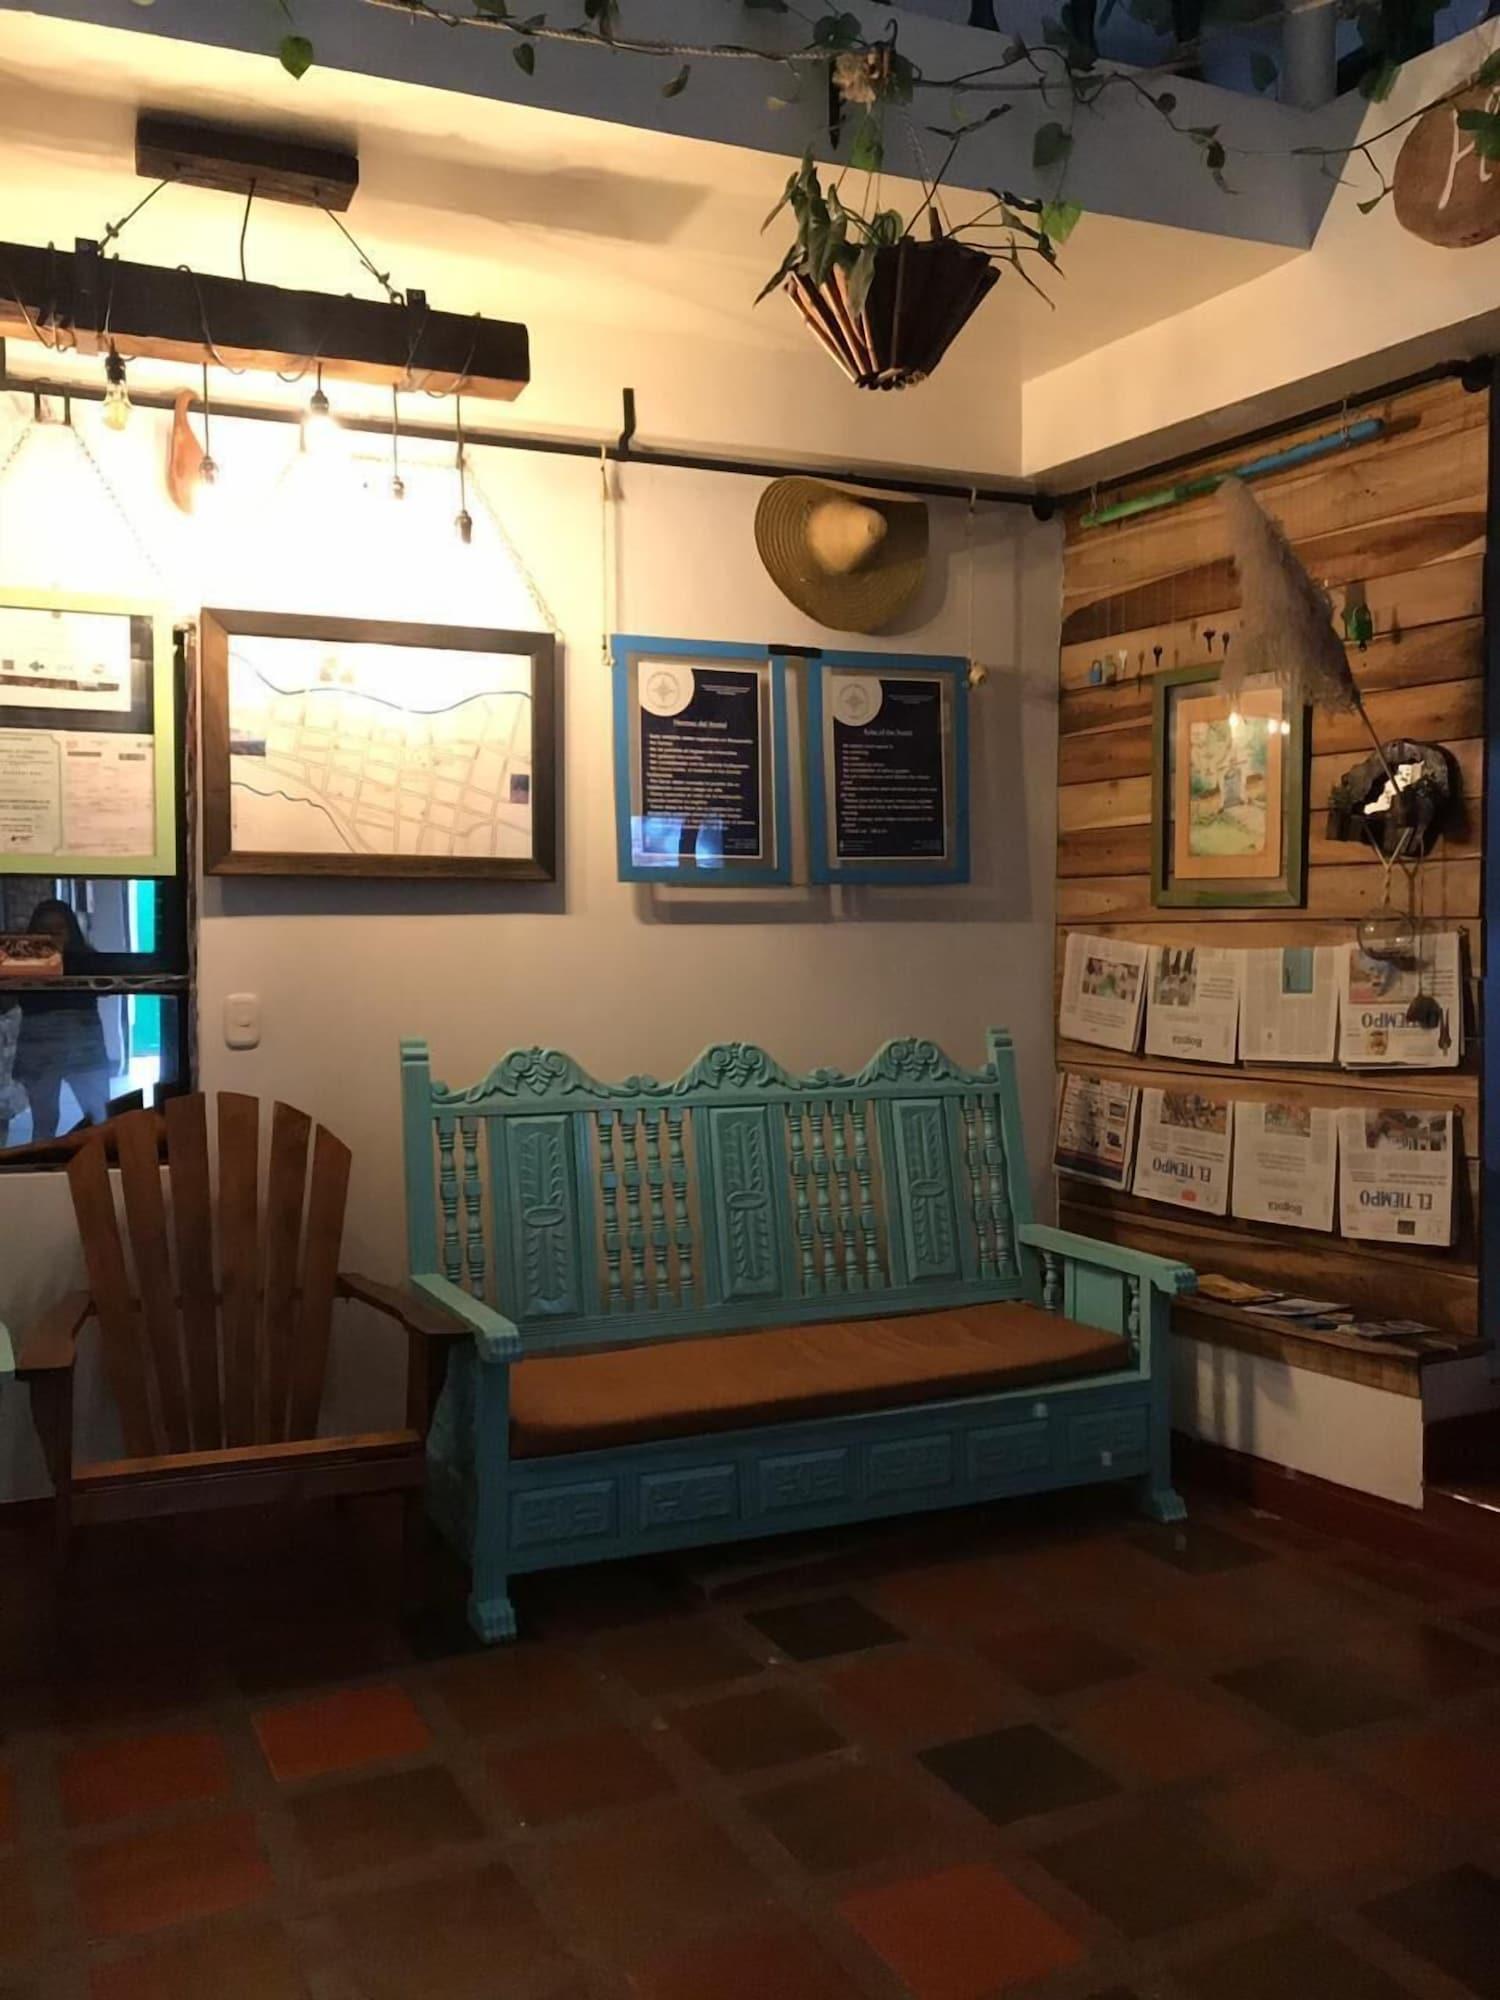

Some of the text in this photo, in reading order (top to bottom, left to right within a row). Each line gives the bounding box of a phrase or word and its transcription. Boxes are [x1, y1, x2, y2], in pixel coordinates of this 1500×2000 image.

[1152, 1157, 1194, 1179] TIEMPO
[1359, 1190, 1433, 1210] EL TIEMPO
